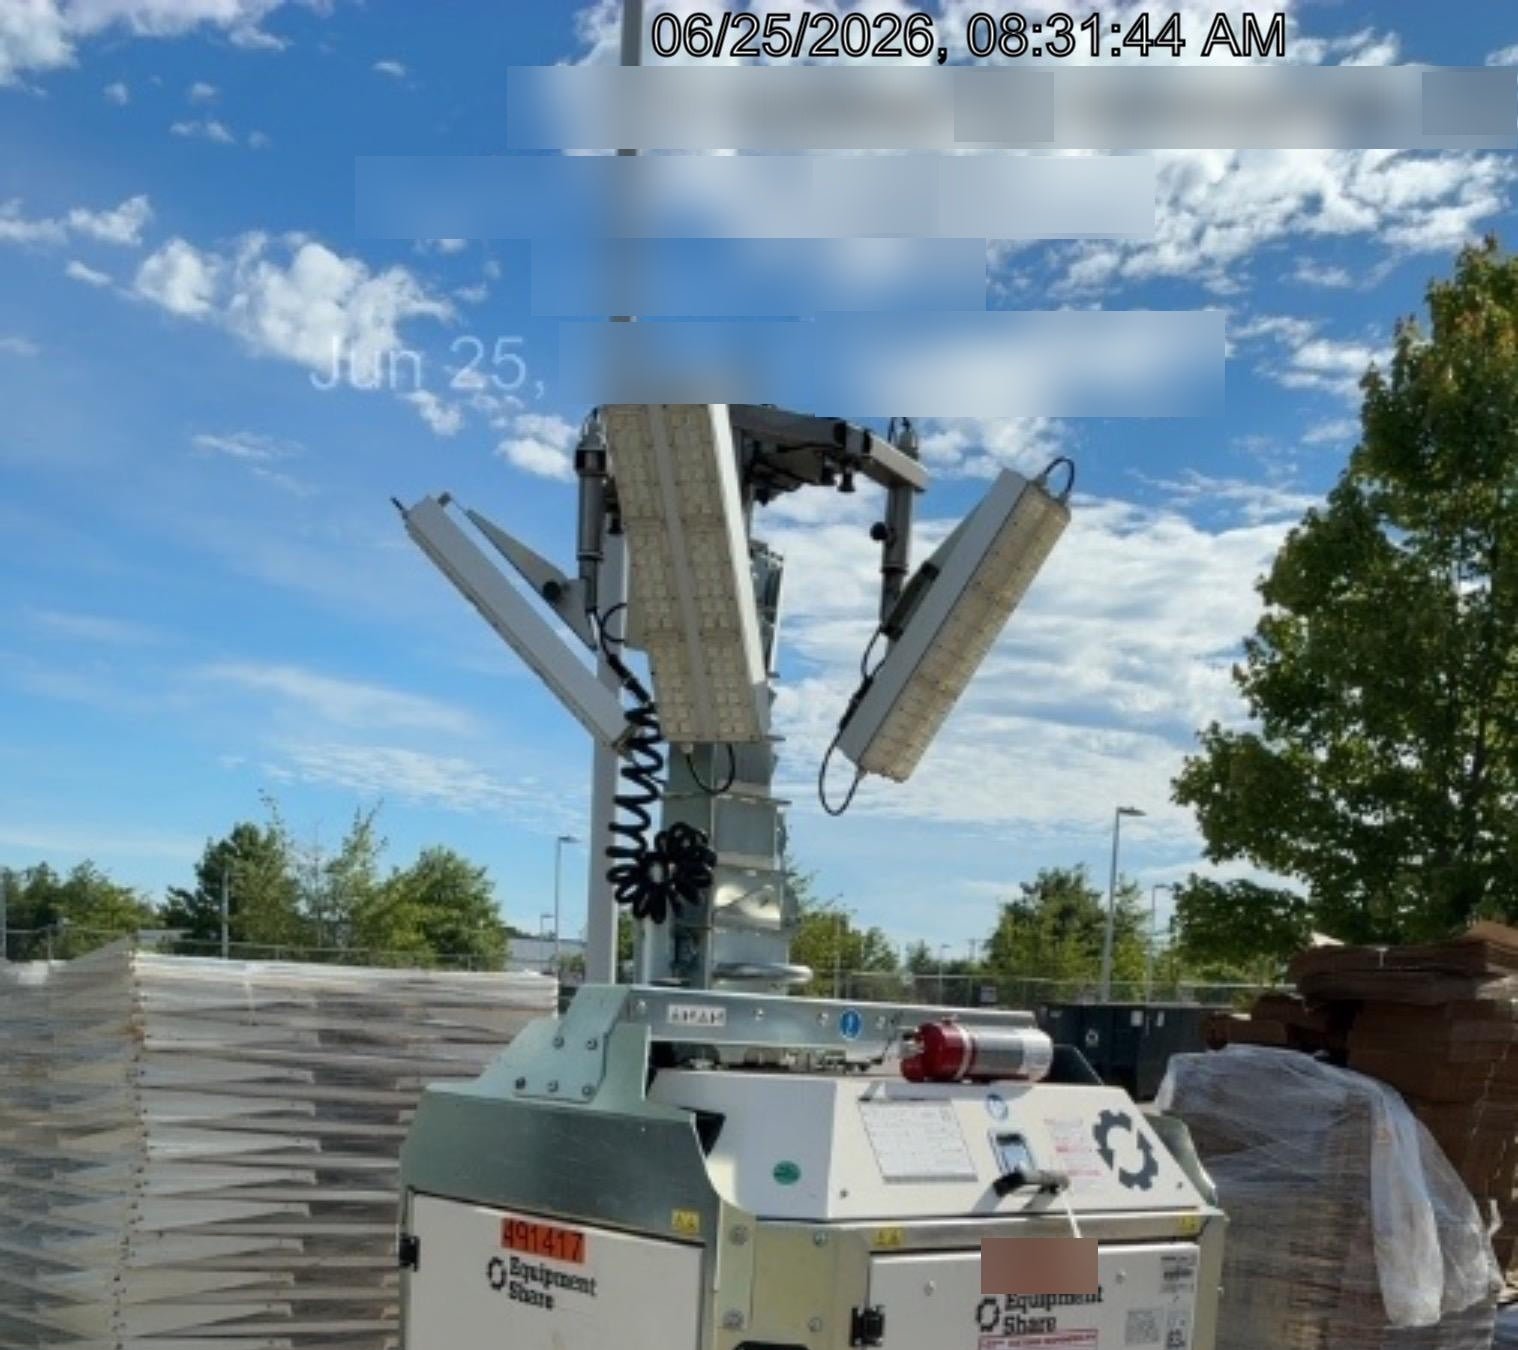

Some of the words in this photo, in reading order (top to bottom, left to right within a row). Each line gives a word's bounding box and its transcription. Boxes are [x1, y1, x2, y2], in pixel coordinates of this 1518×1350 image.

[503, 1218, 585, 1262] 491417
[509, 1256, 597, 1297] Equipment
[508, 1280, 555, 1311] Share
[1003, 1315, 1056, 1336] Share
